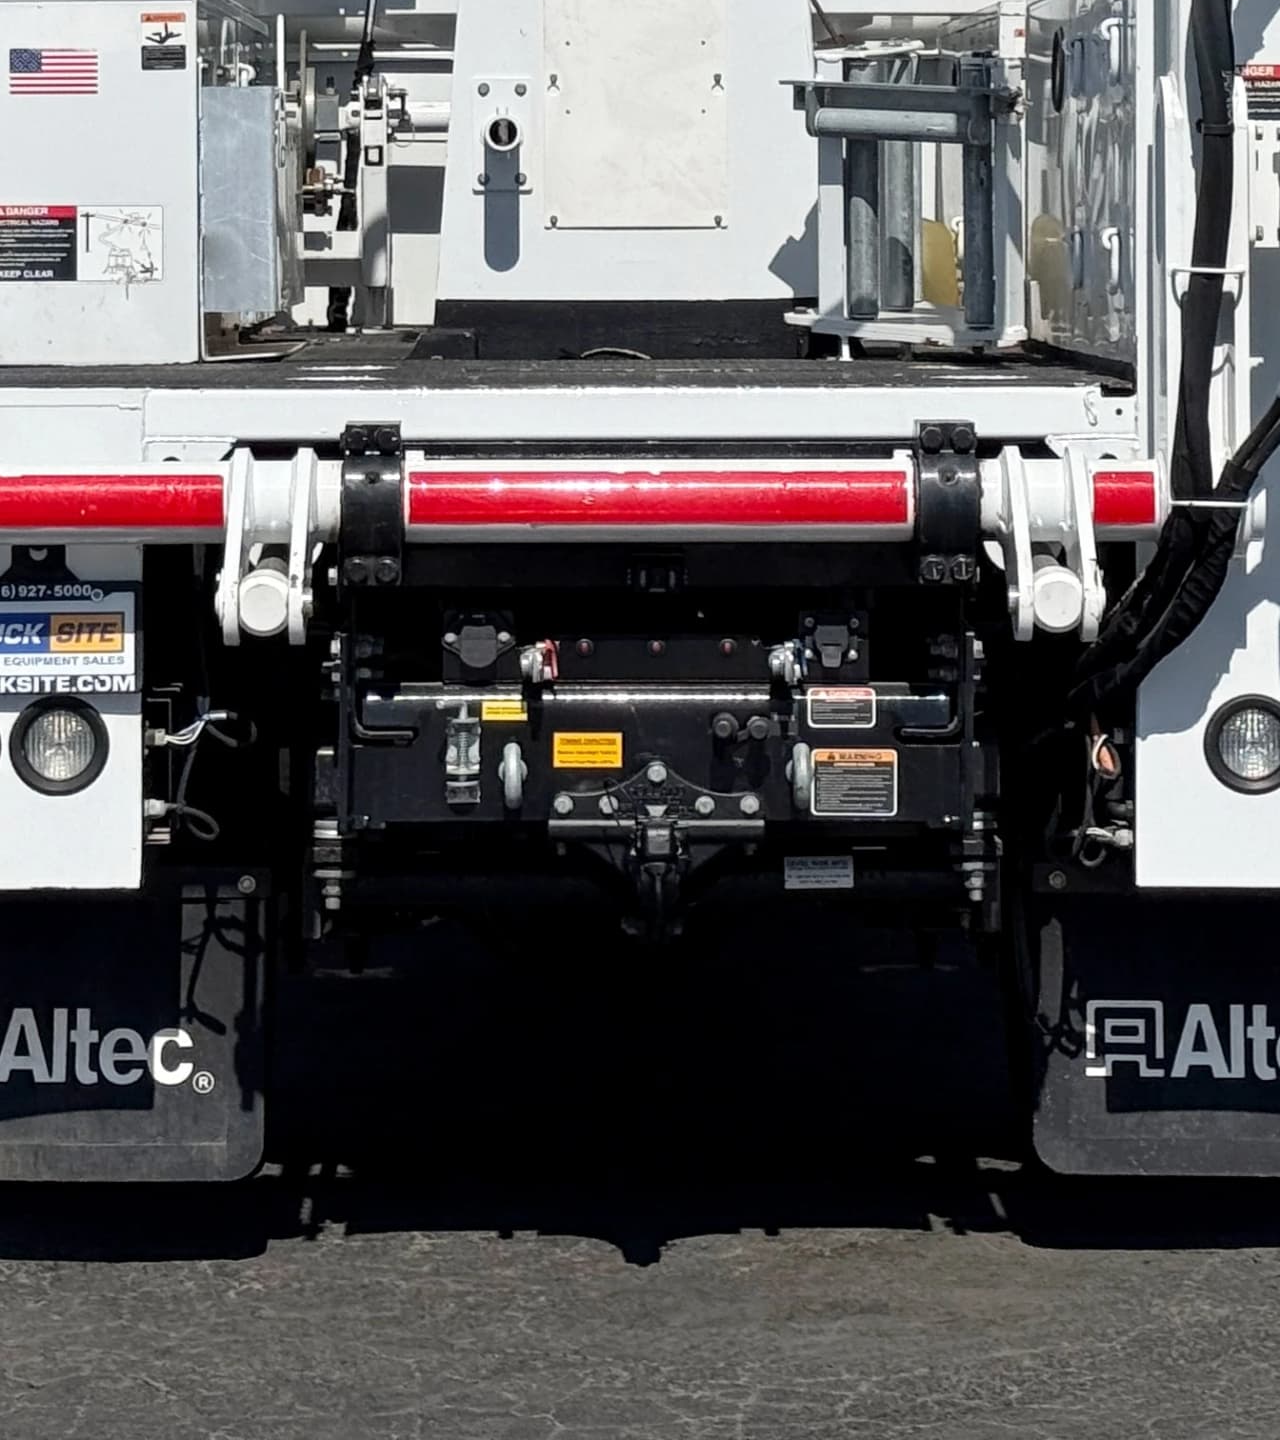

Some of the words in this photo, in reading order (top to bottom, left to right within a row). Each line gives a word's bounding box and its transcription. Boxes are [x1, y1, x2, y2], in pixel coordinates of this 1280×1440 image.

[6, 207, 49, 216] DANGER
[23, 269, 54, 278] CLEAR
[56, 621, 119, 644] SITE
[4, 656, 78, 666] EQUIPMENT
[83, 655, 125, 665] SALES
